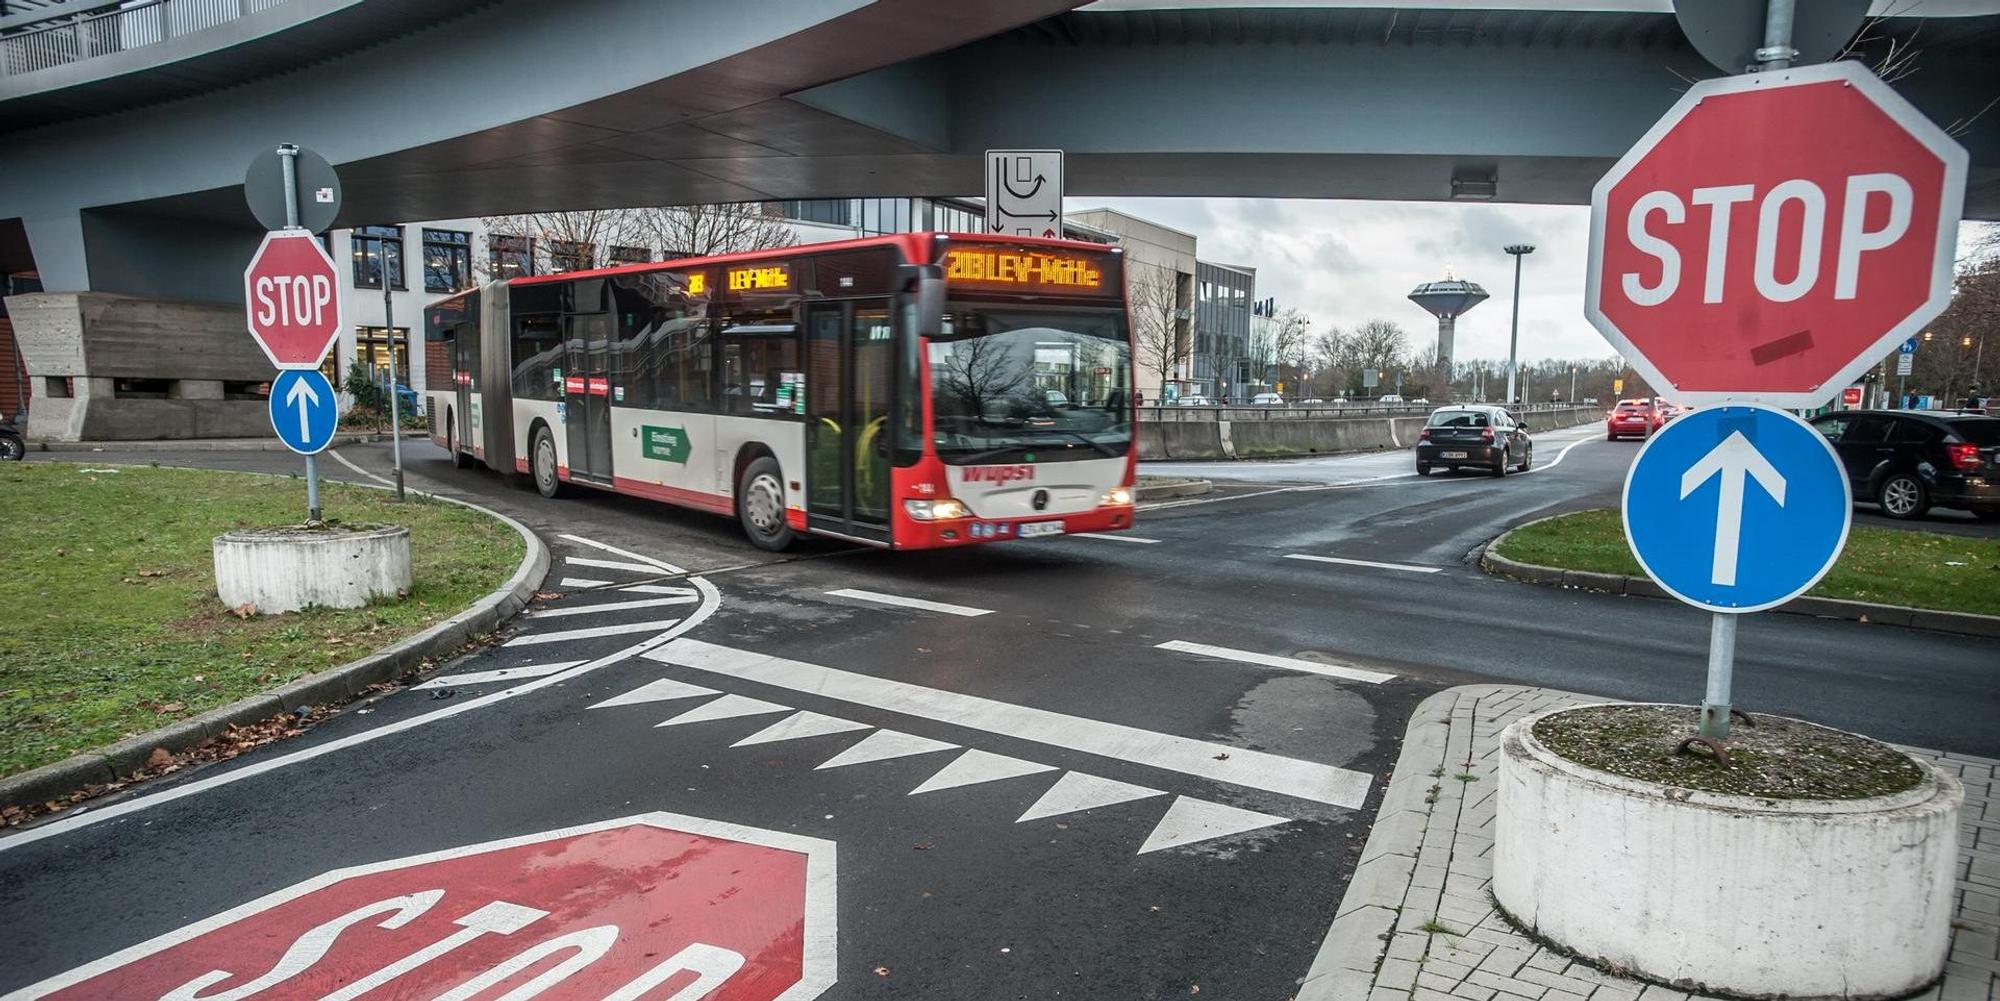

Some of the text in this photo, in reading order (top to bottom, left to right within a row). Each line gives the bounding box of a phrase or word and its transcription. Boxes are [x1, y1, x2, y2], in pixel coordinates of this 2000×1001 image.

[1622, 172, 1914, 306] STOP
[986, 254, 1099, 286] LEV-Mitte
[256, 275, 331, 327] STOP
[962, 465, 1036, 486] wupsi
